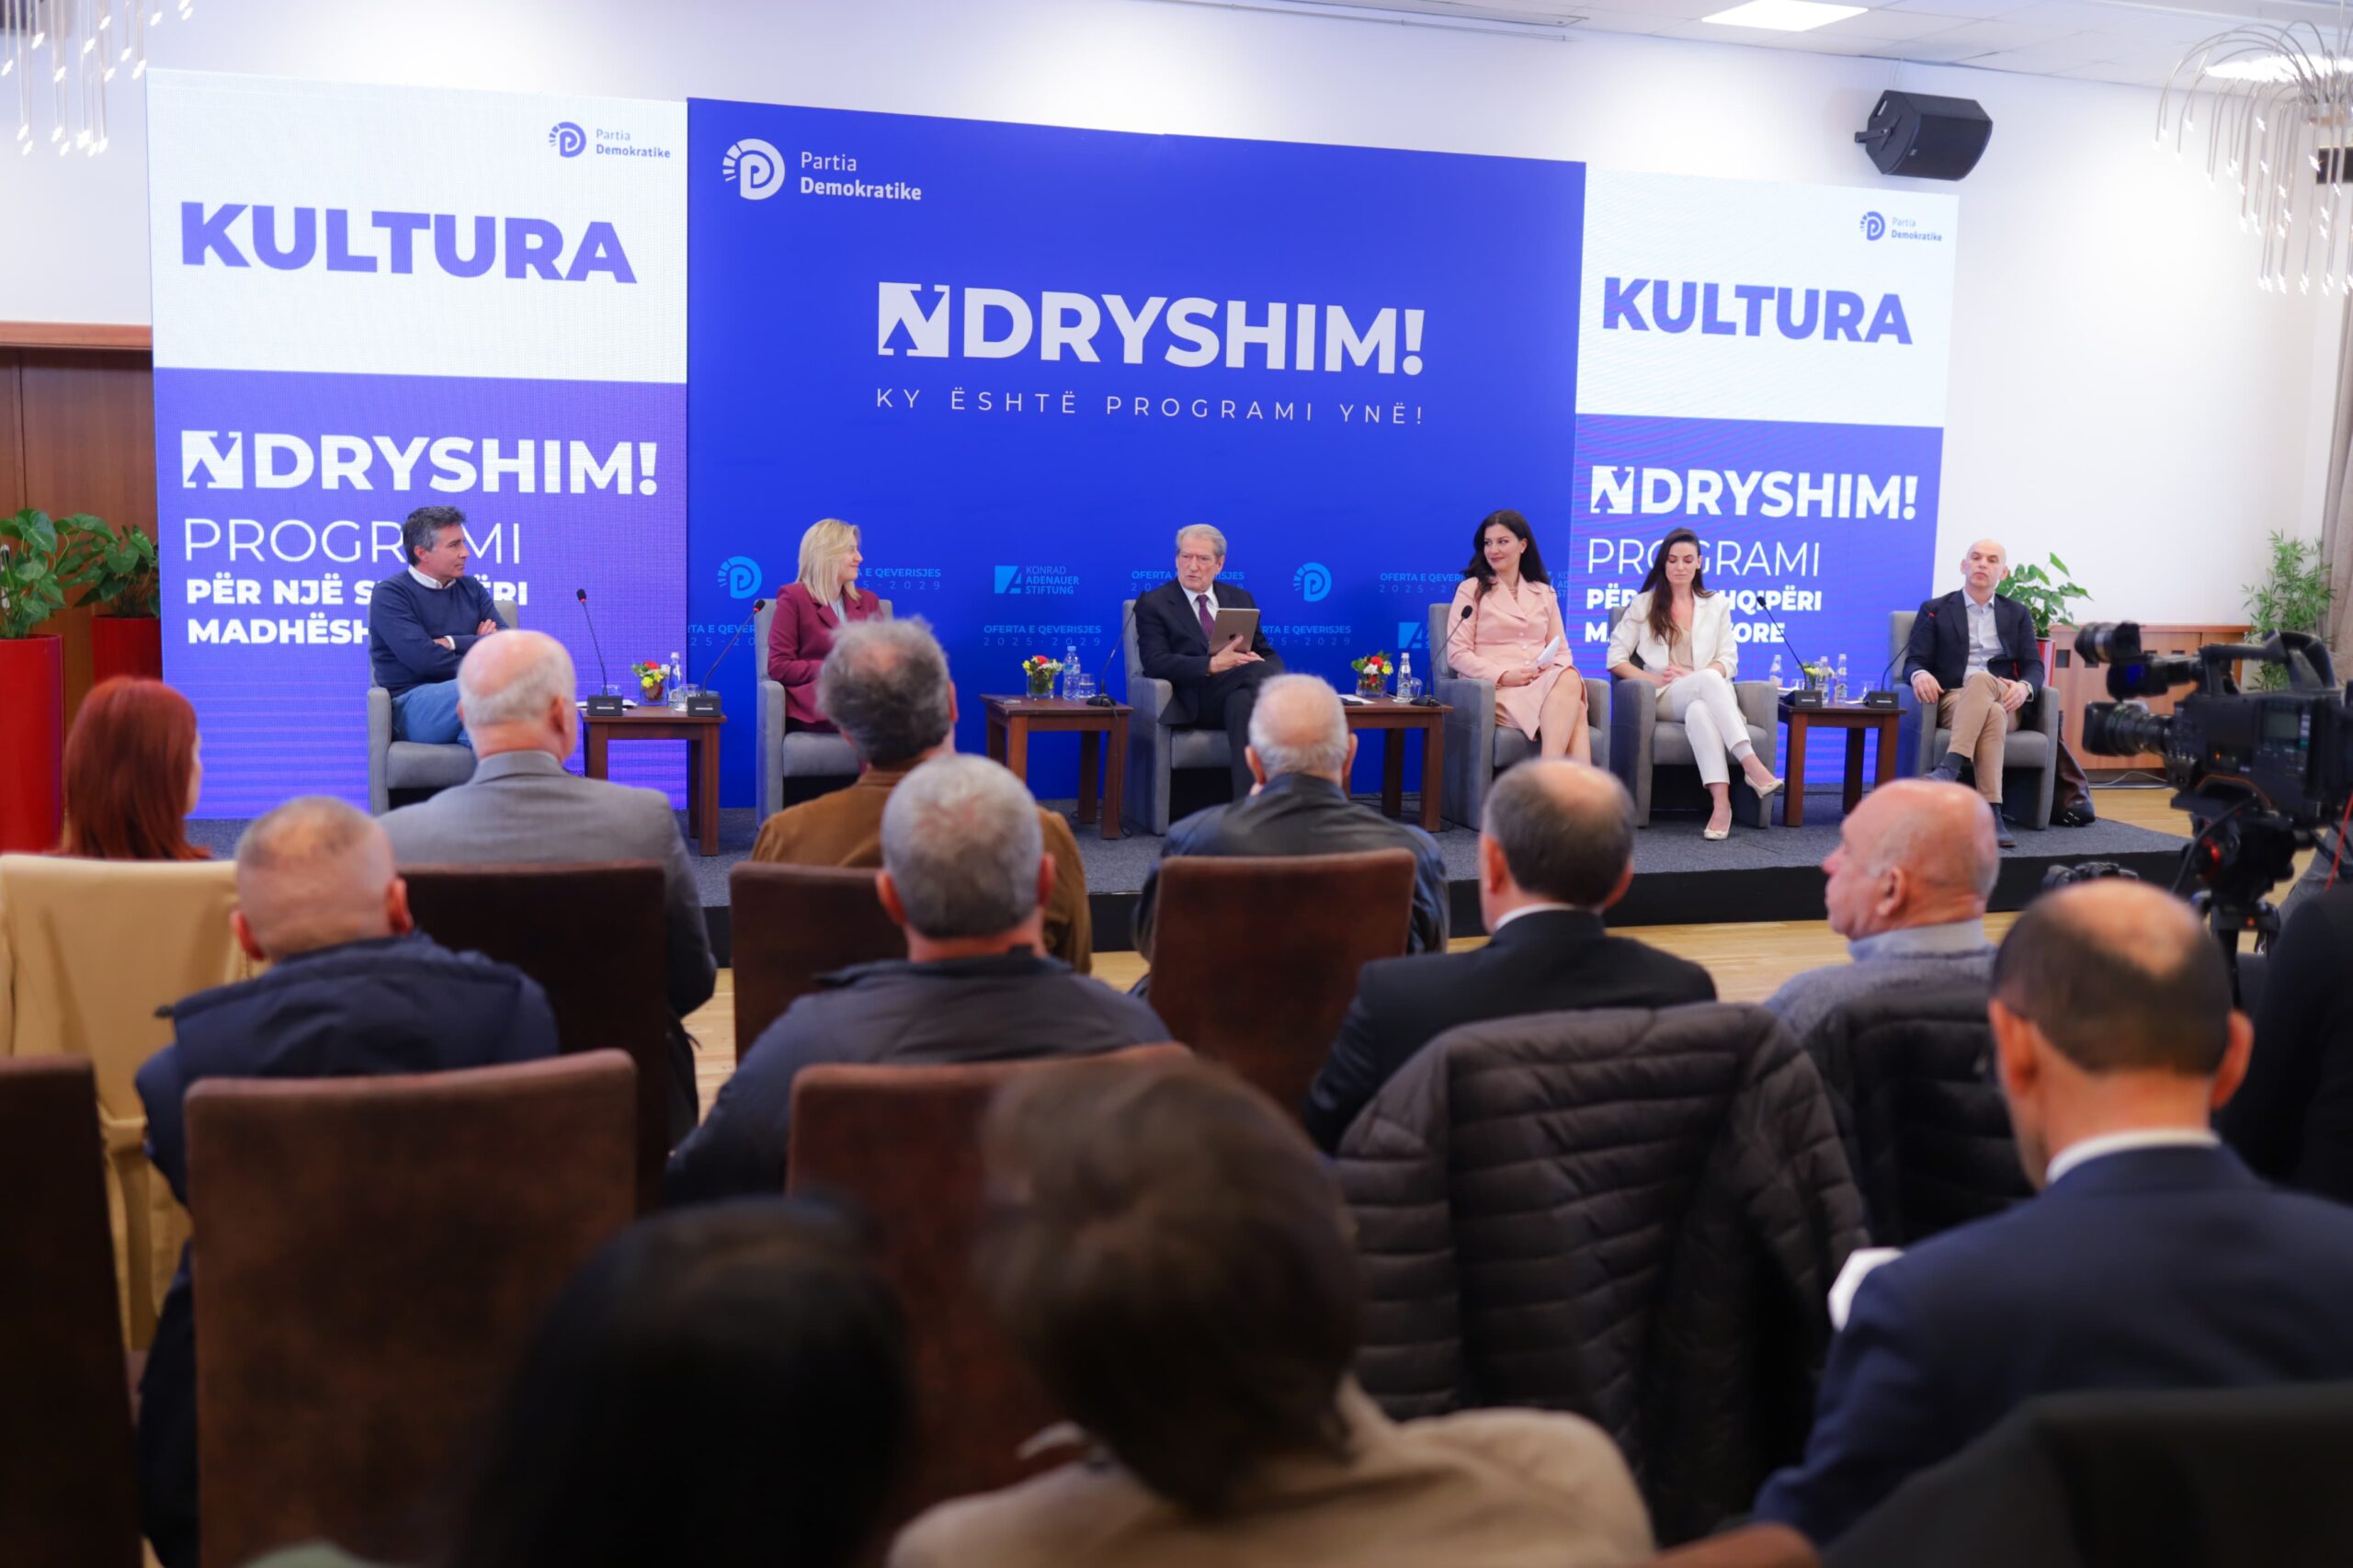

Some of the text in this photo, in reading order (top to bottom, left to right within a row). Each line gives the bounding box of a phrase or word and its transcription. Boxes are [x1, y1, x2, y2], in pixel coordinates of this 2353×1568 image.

[596, 129, 631, 141] Partia
[596, 144, 671, 158] Demokratike
[801, 151, 858, 172] Partia
[800, 176, 922, 200] Demokratike
[1892, 217, 1916, 227] Partia
[1891, 230, 1942, 241] Demokratike
[181, 200, 637, 284] KULTURA
[1602, 277, 1913, 345] KULTURA
[878, 281, 1426, 376] NDRYSHIM!
[877, 387, 1422, 424] KY ËSHTË PROGRAMI YNË!
[181, 430, 659, 495] NDRYSHIM!
[1590, 465, 1918, 520] NDRYSHIM!
[185, 517, 519, 564] PROGRMI
[865, 568, 872, 577] E
[875, 567, 942, 578] QEVERISJES
[1025, 565, 1067, 575] KONRAD
[1131, 571, 1173, 580] OFERTA
[1025, 575, 1080, 585] ADENAUER
[1380, 573, 1466, 583] OFERTA E QEVERI
[187, 572, 261, 605] PËR
[273, 573, 344, 605] NJË
[863, 580, 940, 590] 5-2029
[1025, 585, 1074, 596] STIFTUNG
[1380, 584, 1448, 594] 2025-2
[1718, 585, 1823, 615] HQIPËRI
[188, 612, 369, 644] MADHËSH
[983, 625, 1101, 635] OFERTA E QEVERISJES
[1283, 625, 1290, 634] E
[1292, 625, 1351, 635] QEVERISJES
[1268, 636, 1351, 646] 25-2029
